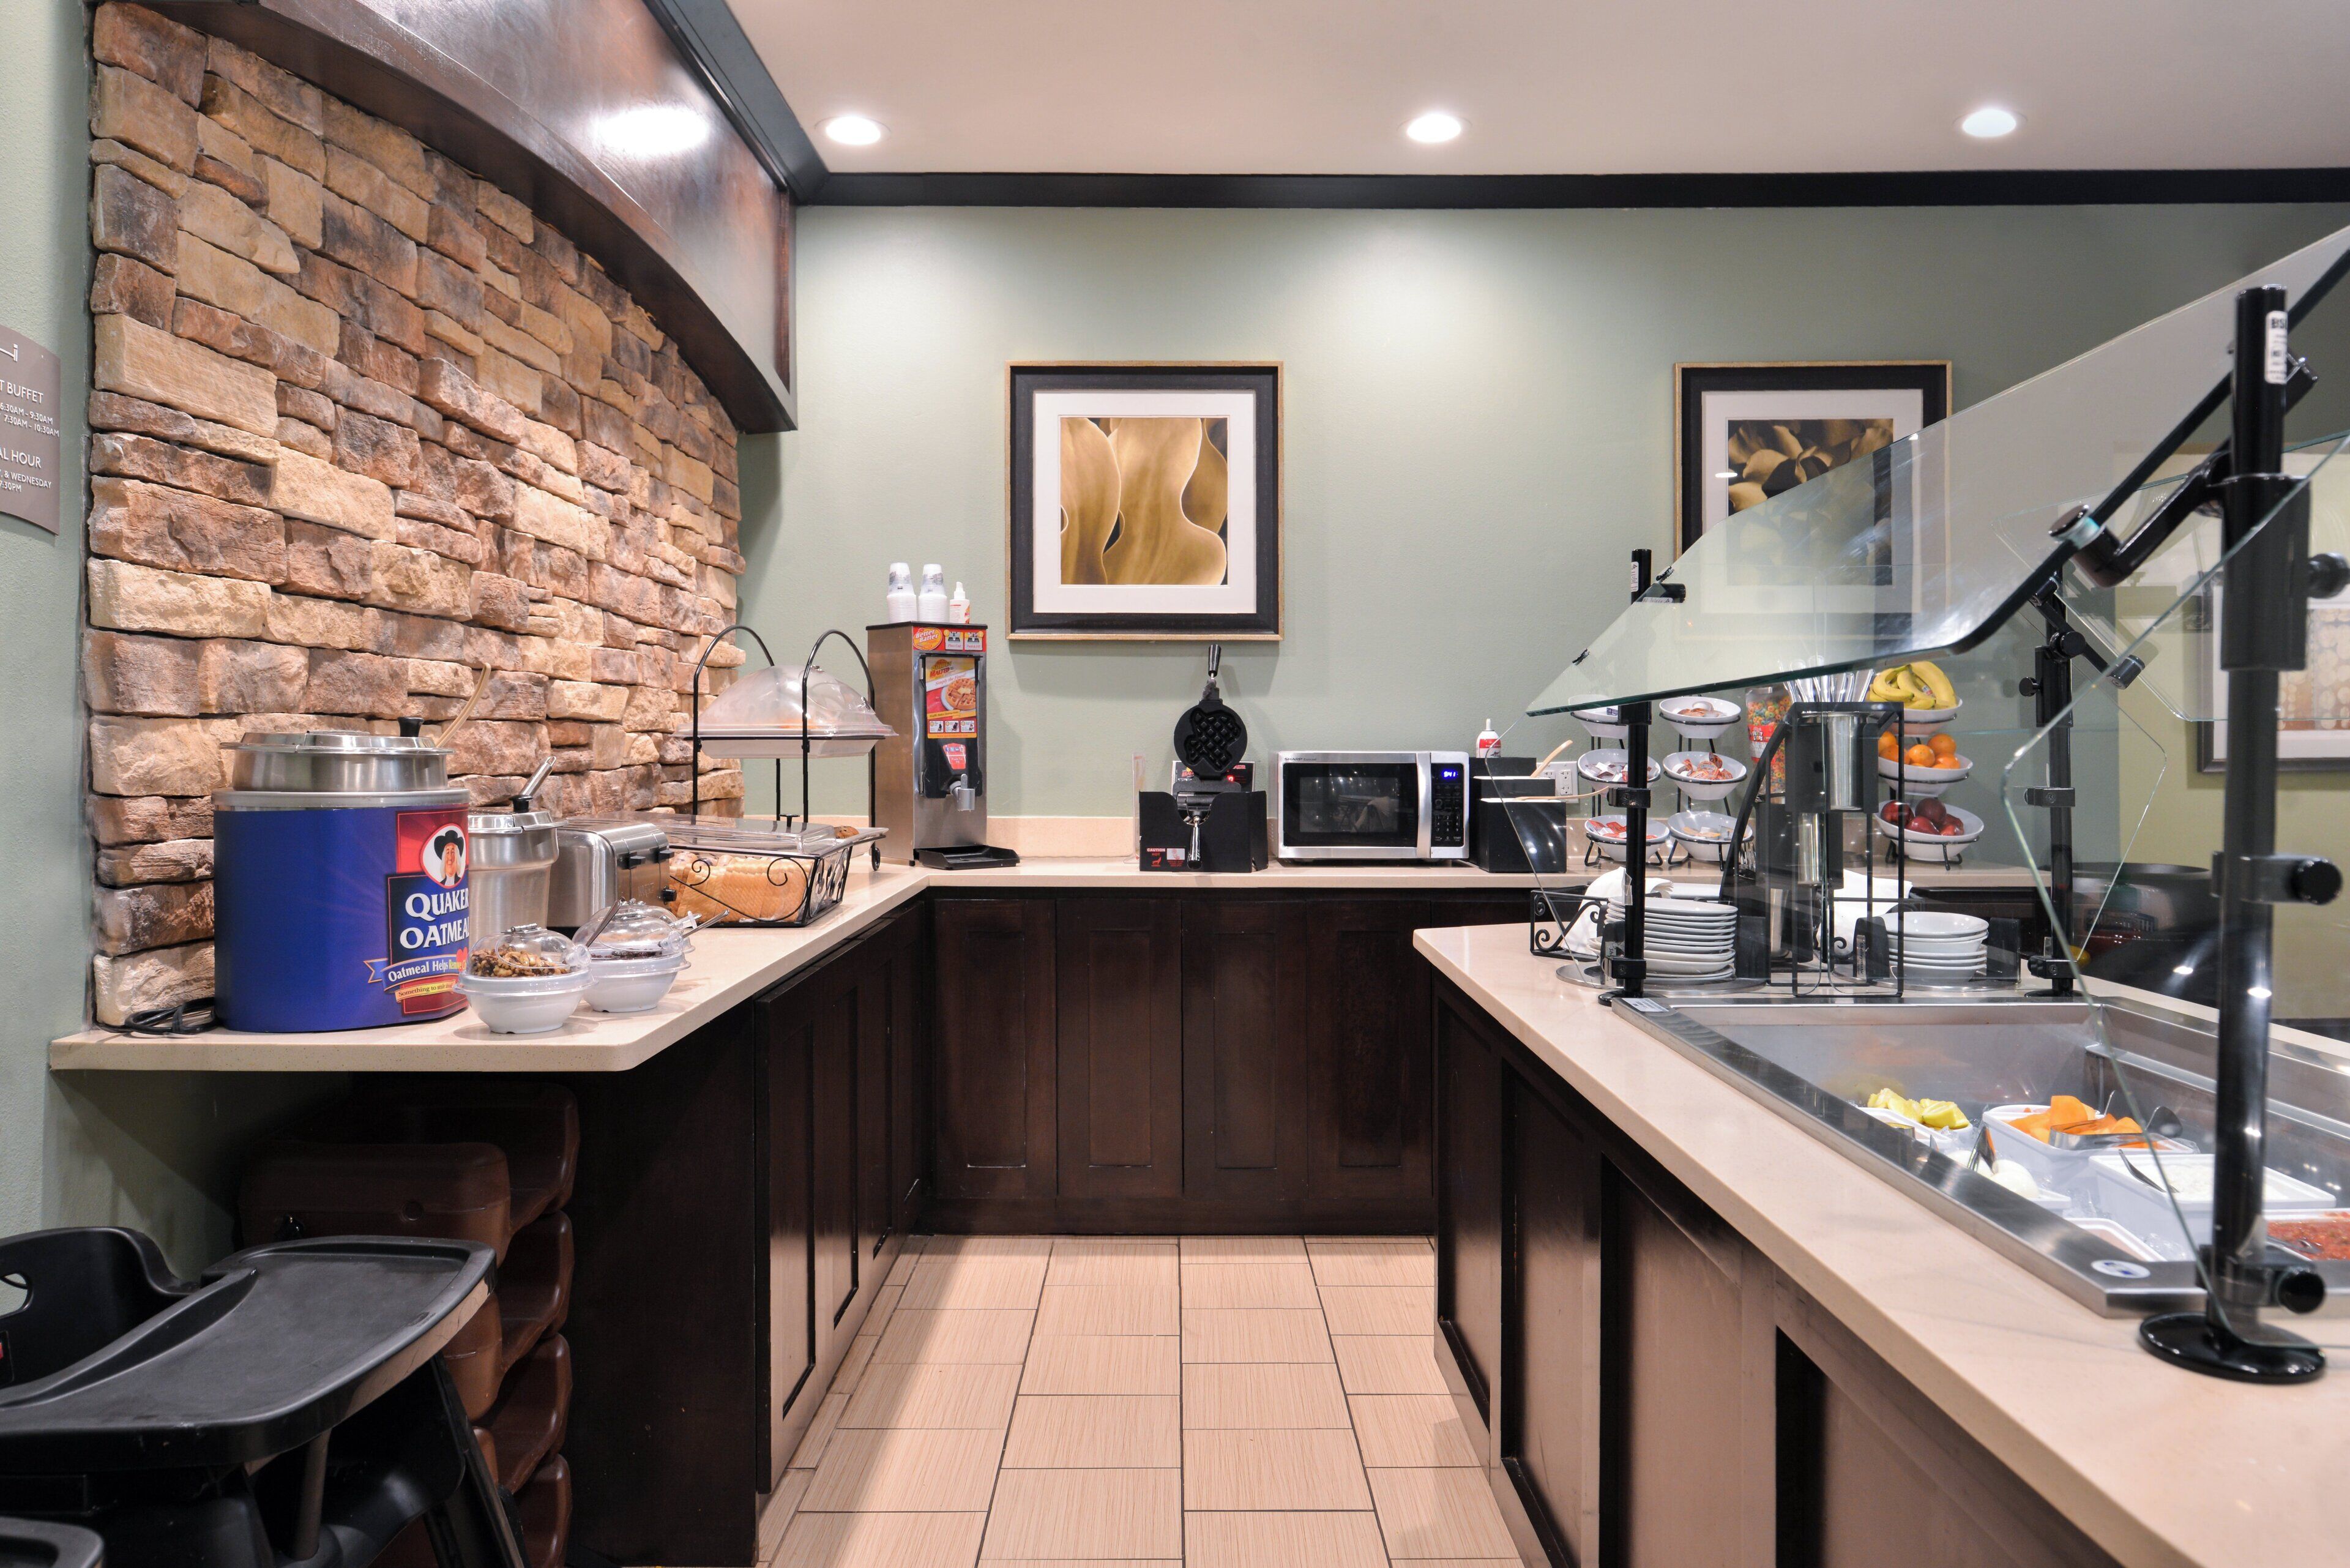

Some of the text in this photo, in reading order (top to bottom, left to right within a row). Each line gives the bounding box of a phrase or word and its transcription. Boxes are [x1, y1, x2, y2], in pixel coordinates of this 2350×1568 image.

[7, 381, 43, 403] BUFFET
[4, 414, 28, 428] 7:30AM
[34, 424, 59, 437] 10:30AM
[29, 411, 53, 425] 9:30AM
[11, 449, 42, 468] HOUR
[10, 471, 51, 488] WEDNESDAY
[916, 629, 935, 639] Better
[919, 634, 939, 643] Batter
[388, 961, 430, 982] Oatmeal
[432, 959, 448, 973] Helps
[398, 985, 430, 996] Something
